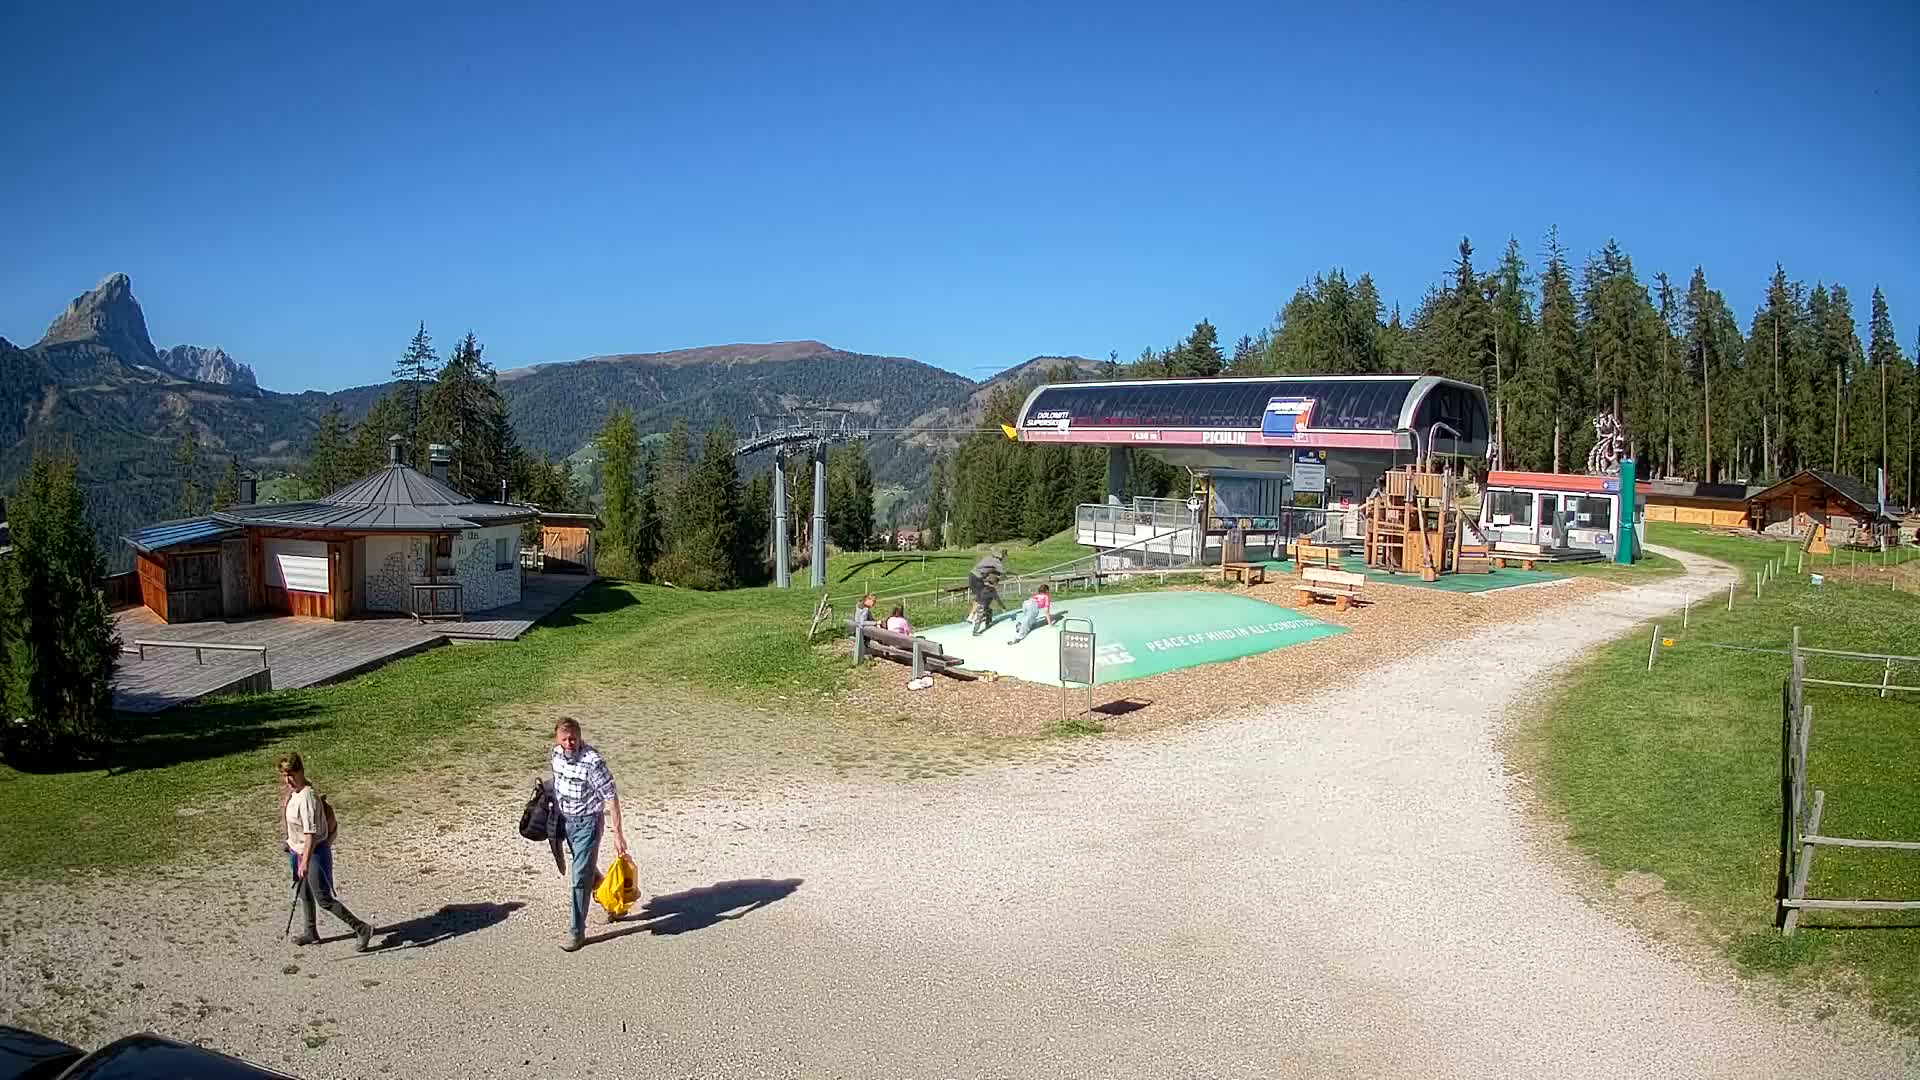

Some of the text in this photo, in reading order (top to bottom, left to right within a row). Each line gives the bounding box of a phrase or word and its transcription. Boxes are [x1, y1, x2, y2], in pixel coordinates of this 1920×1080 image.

[1037, 411, 1070, 419] DOLOMITI
[1202, 431, 1247, 445] PICULIN
[1144, 635, 1190, 652] PEACE
[1187, 632, 1205, 645] OF
[1205, 629, 1236, 641] MIND
